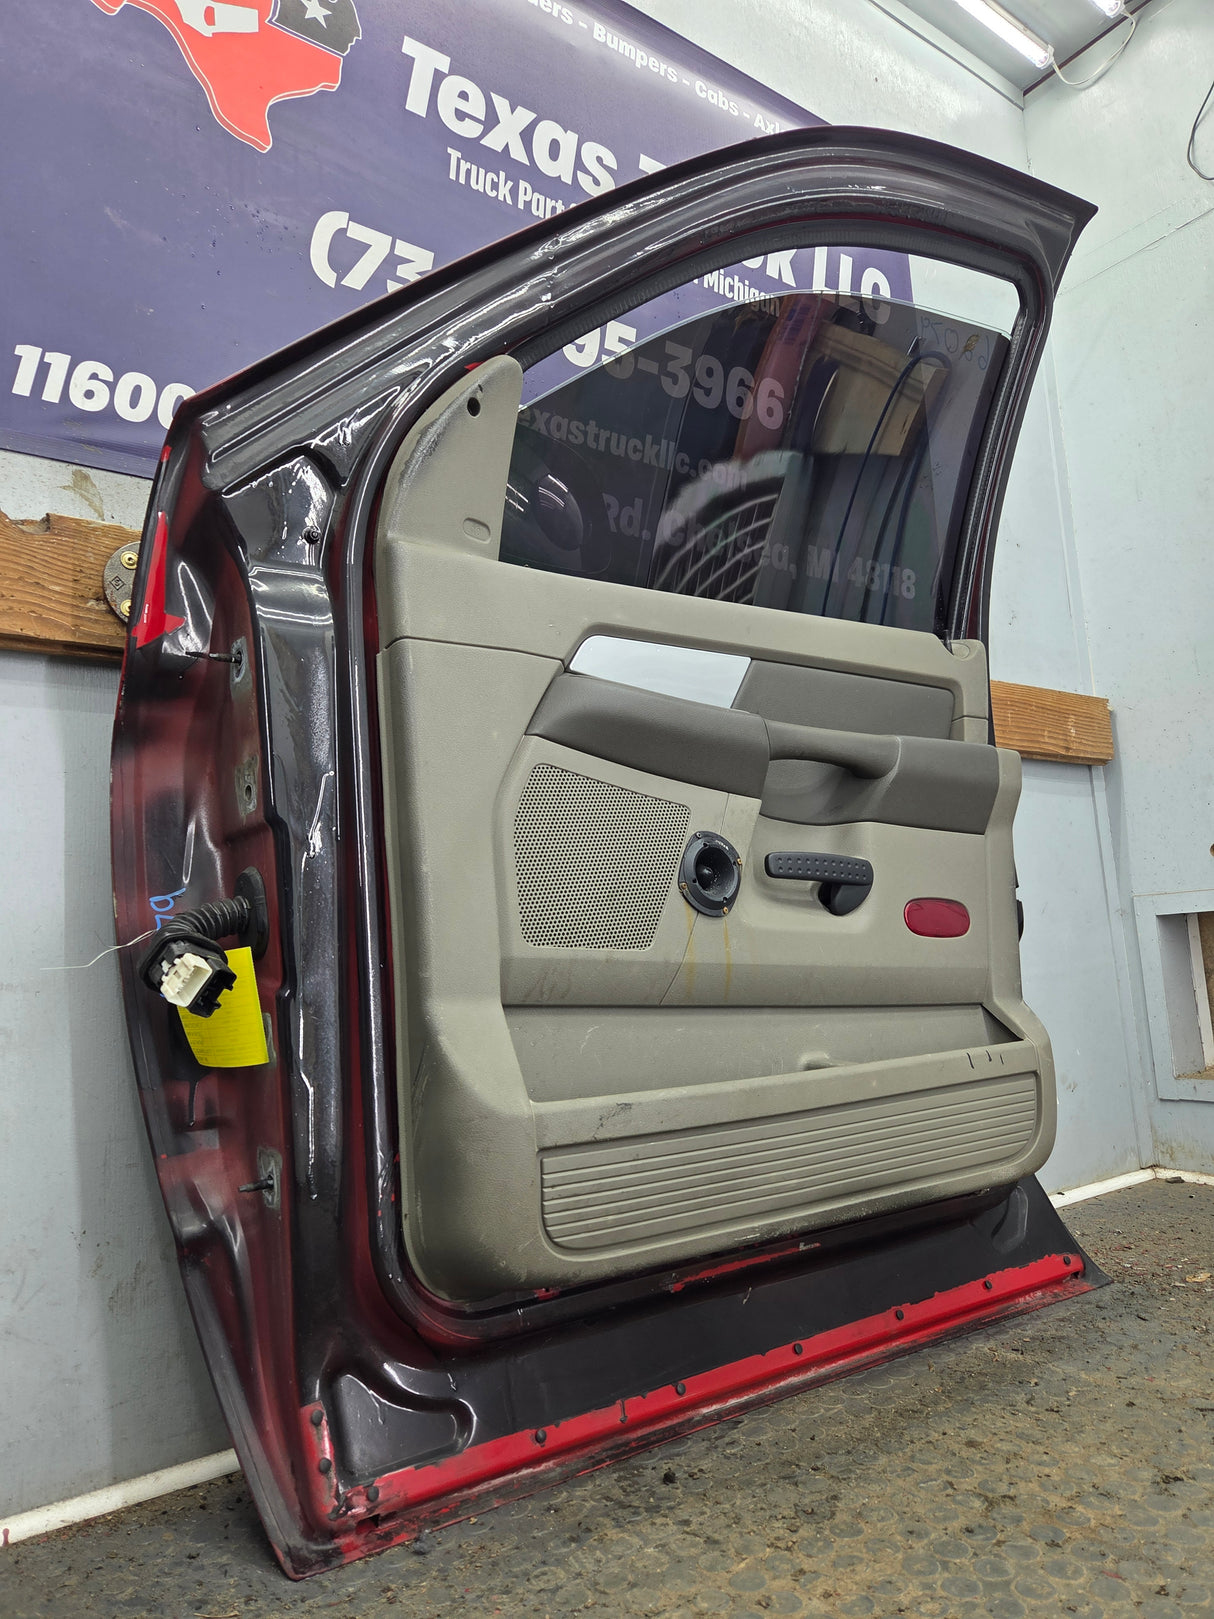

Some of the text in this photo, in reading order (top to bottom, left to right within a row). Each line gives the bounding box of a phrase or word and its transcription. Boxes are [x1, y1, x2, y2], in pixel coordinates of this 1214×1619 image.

[402, 36, 617, 197] Texas
[593, 22, 678, 83] Bumpers
[695, 80, 739, 117] Cabs
[755, 113, 791, 135] Axl
[447, 147, 577, 219] Truck Part
[704, 269, 780, 317] Michigan
[11, 344, 198, 430] 11600
